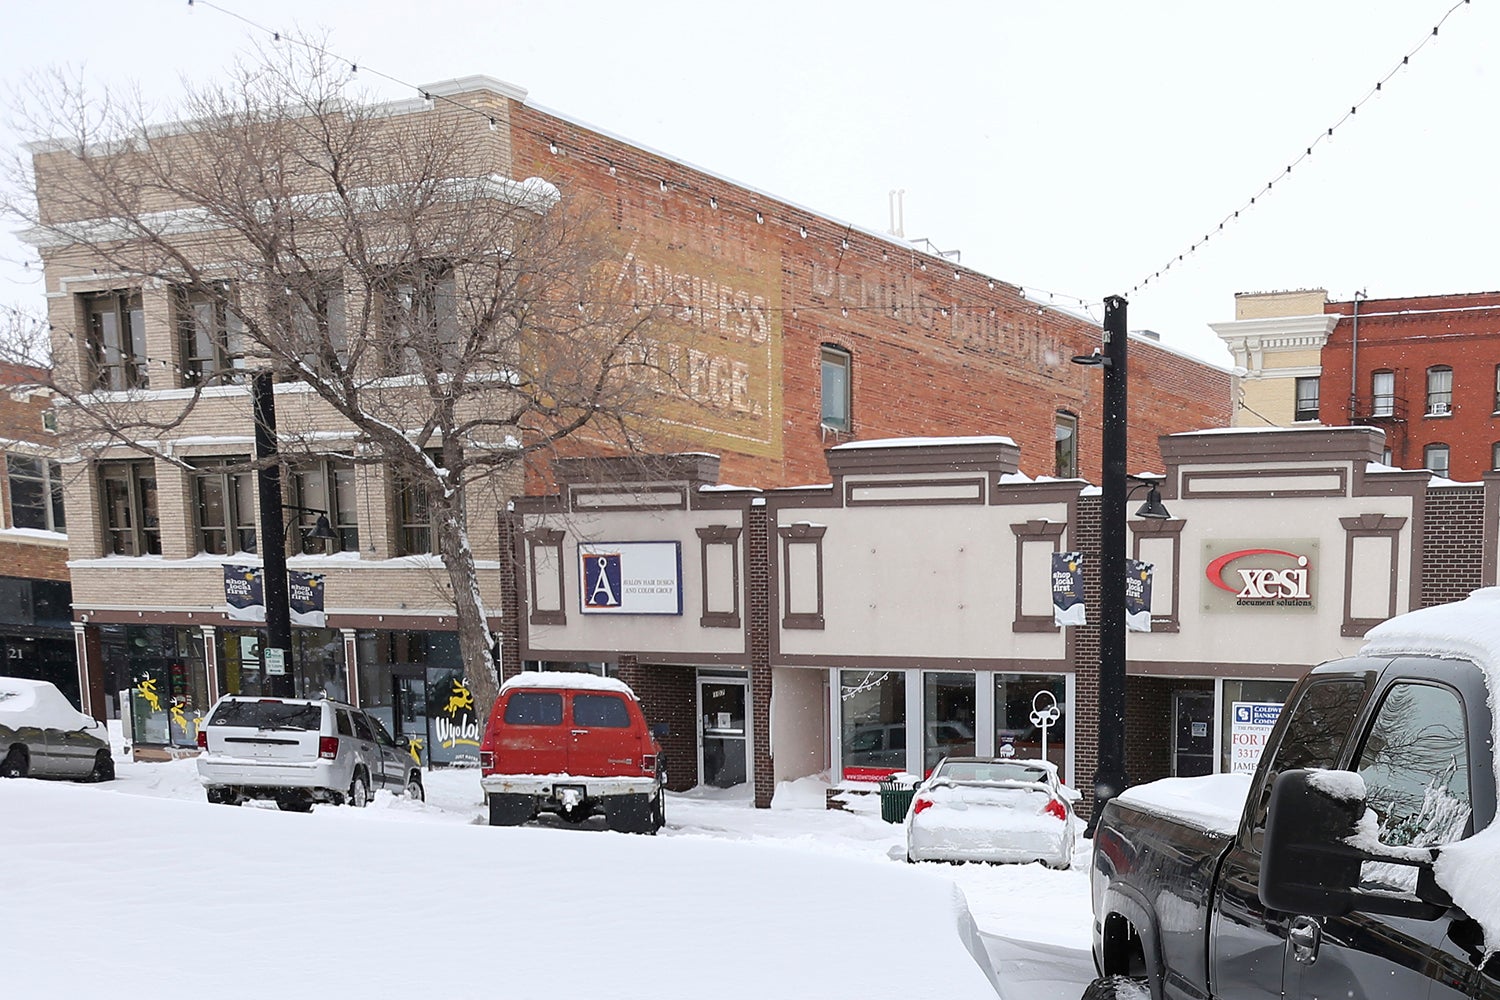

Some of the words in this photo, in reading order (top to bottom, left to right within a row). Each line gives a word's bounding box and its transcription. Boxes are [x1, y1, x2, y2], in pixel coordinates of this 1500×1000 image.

[1053, 571, 1070, 579] shop
[1236, 555, 1310, 598] xesi
[225, 578, 248, 586] shop
[1056, 577, 1073, 585] local
[1126, 577, 1141, 585] shop
[226, 588, 248, 596] first
[291, 584, 311, 592] shop
[1053, 584, 1070, 592] first
[1128, 583, 1143, 593] local
[294, 589, 313, 597] local
[1126, 589, 1140, 598] first
[8, 648, 23, 659] 21
[1233, 733, 1258, 745] FOR
[1237, 748, 1260, 759] 3317
